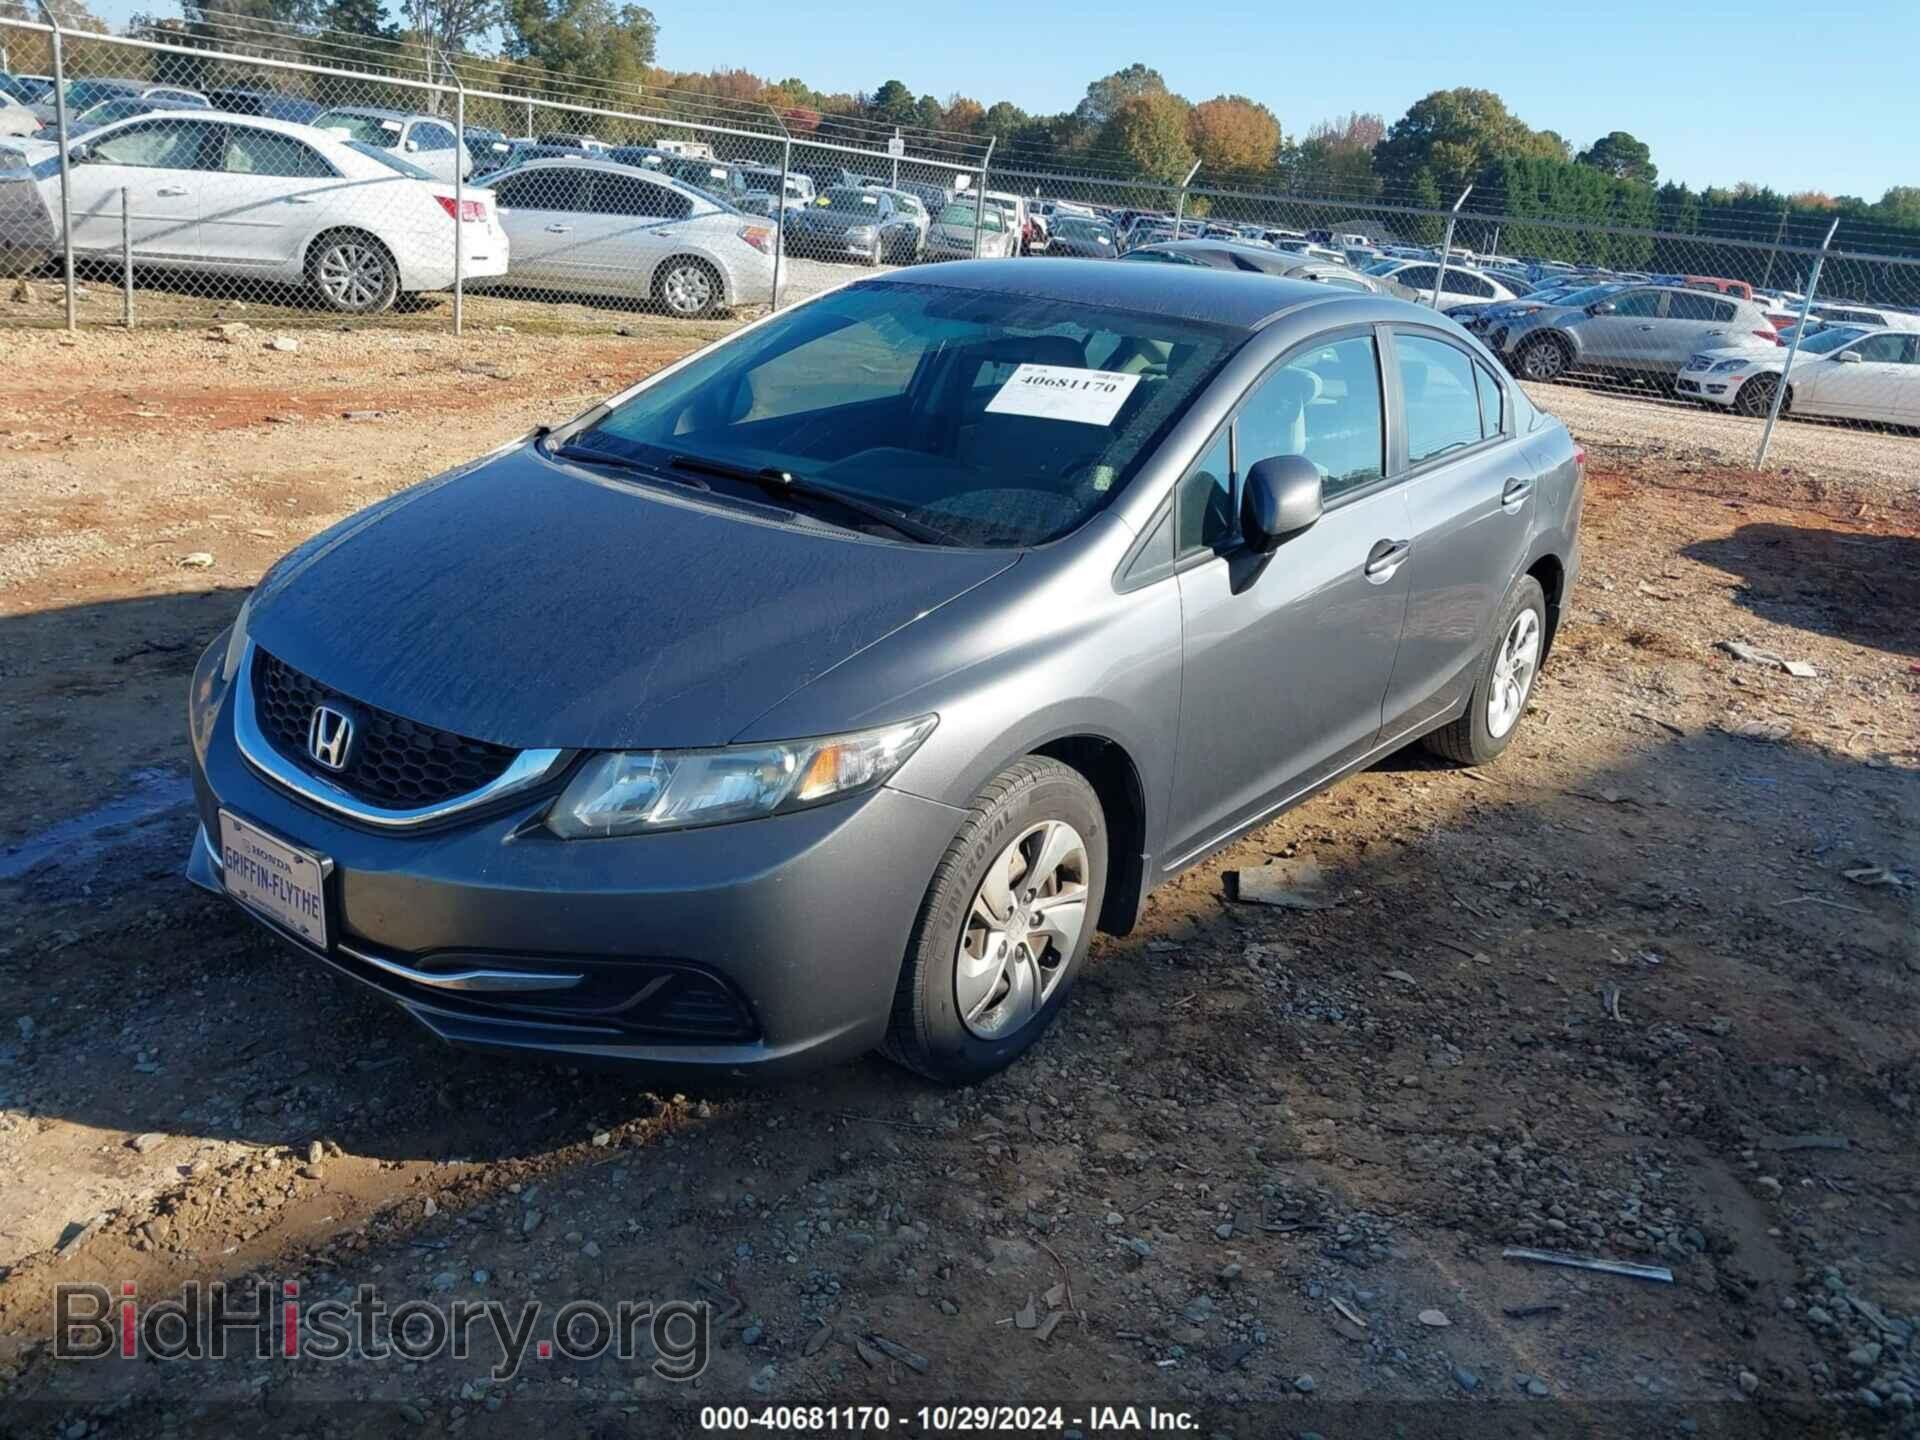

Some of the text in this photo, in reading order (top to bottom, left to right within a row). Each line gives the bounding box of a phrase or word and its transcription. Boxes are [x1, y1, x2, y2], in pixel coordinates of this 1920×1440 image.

[1021, 375, 1117, 393] 40681170
[223, 845, 321, 920] GRIFFIN-FLYTHE
[251, 844, 293, 874] HONDA
[942, 810, 1013, 931] UNIROYAL
